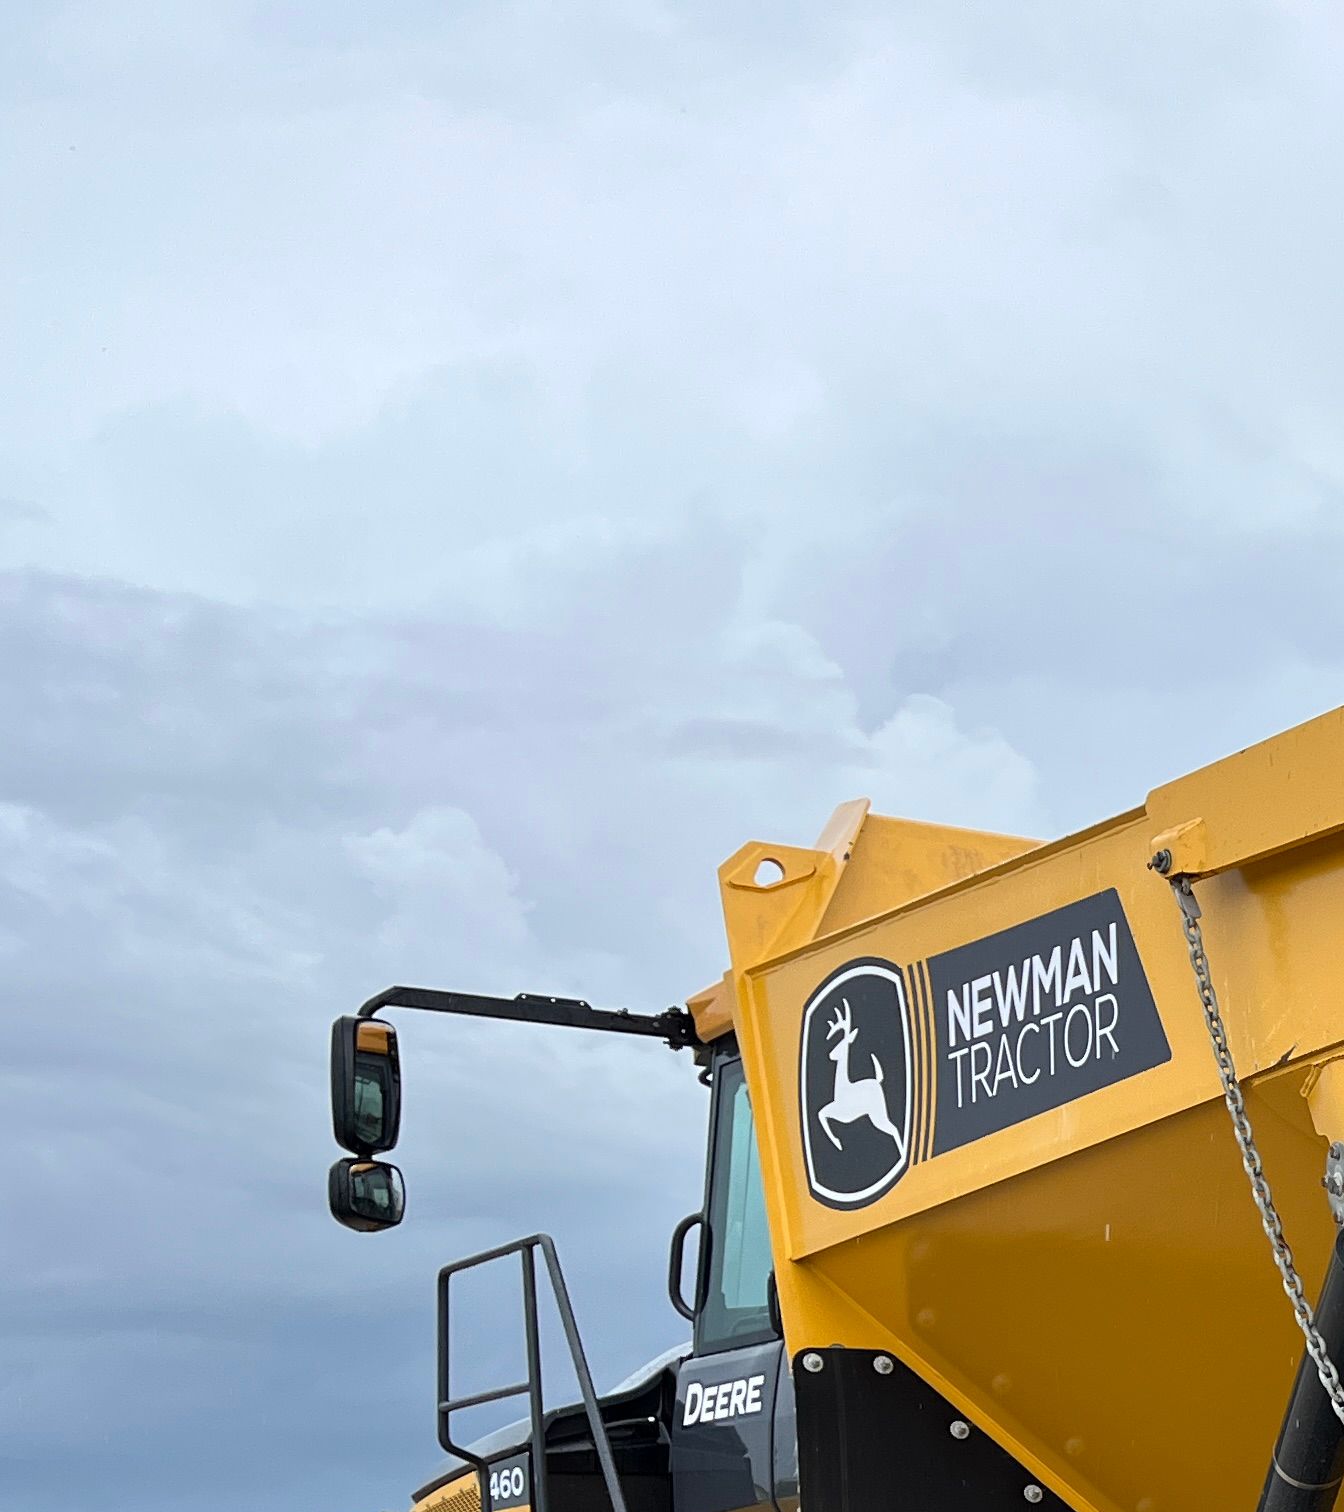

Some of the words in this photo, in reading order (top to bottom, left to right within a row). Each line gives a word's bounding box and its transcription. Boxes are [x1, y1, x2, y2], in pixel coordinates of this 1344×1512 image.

[946, 922, 1119, 1047] NEWMAN
[947, 993, 1120, 1108] TRACTOR
[682, 1373, 765, 1427] DEERE
[490, 1466, 524, 1501] 460
